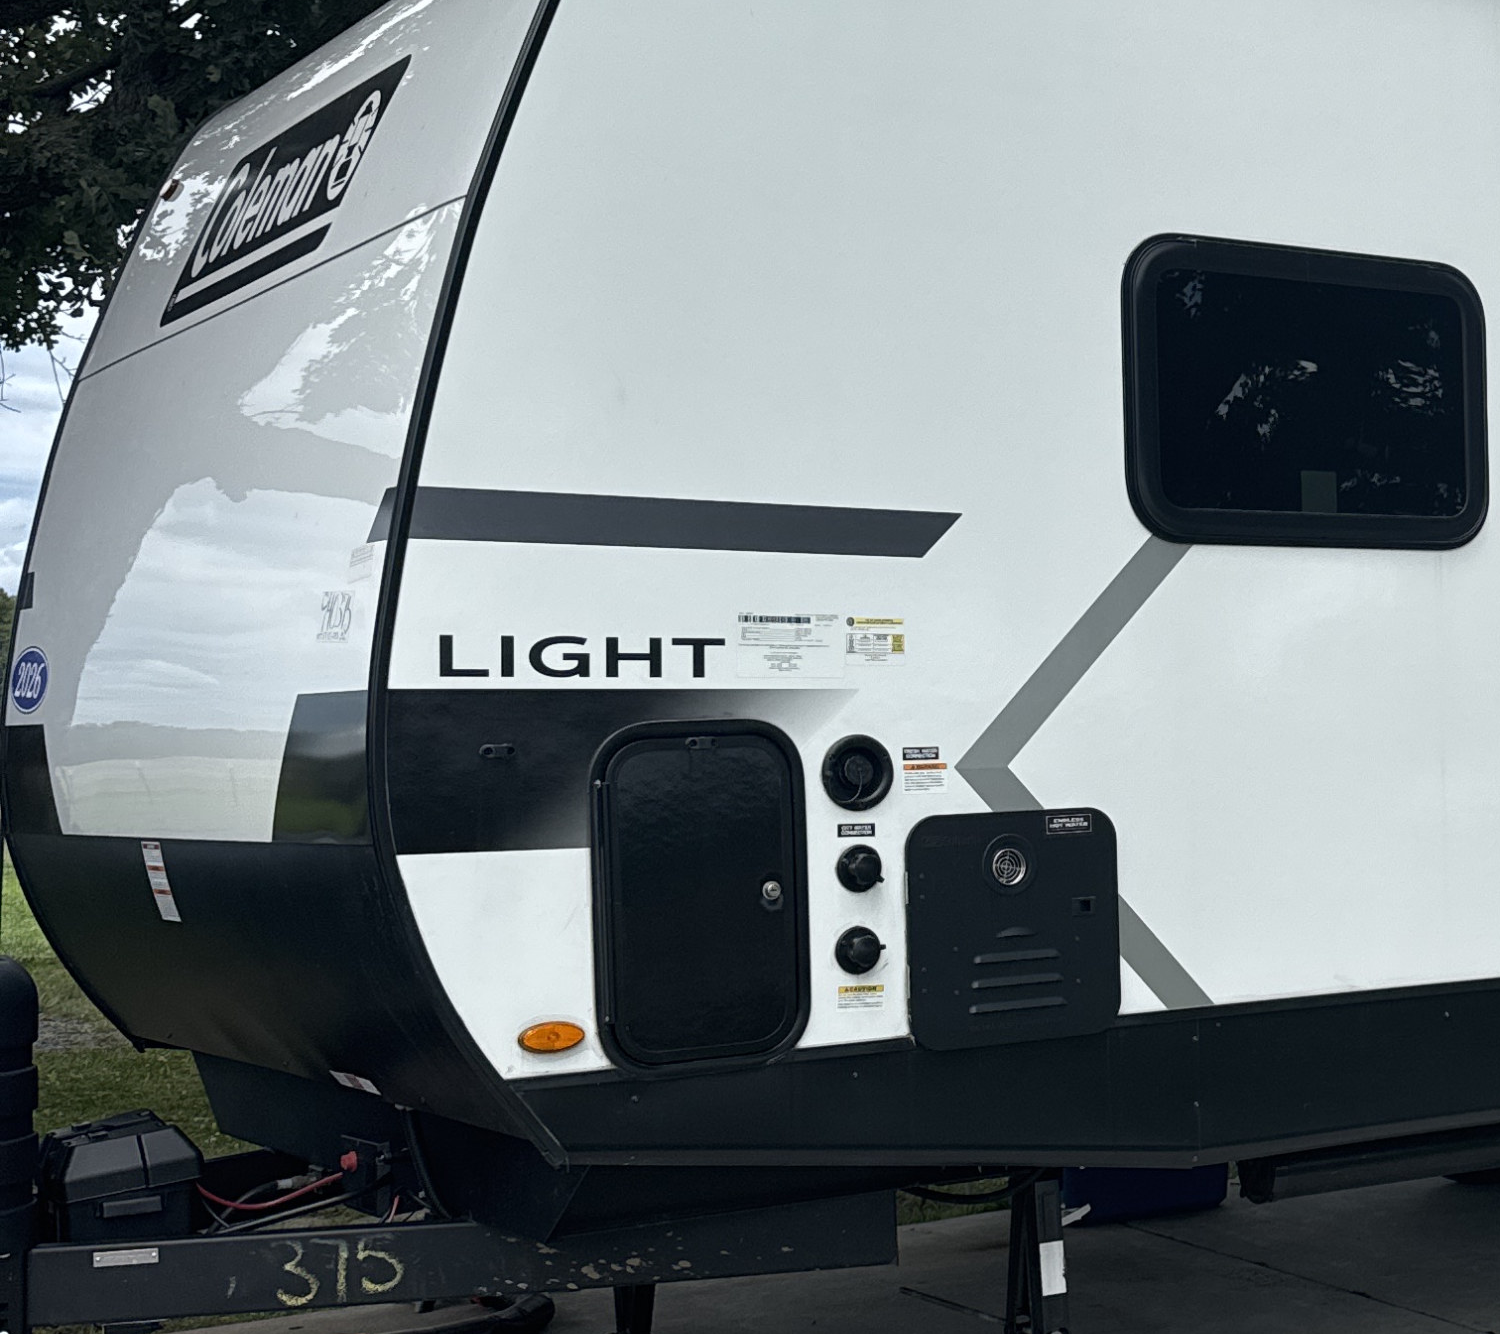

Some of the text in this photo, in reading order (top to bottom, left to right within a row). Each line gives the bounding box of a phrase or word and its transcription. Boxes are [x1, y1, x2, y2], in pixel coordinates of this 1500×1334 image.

[190, 134, 341, 279] Coleman
[13, 661, 46, 700] 2026
[438, 634, 726, 679] LIGHT
[271, 1233, 404, 1307] 375
